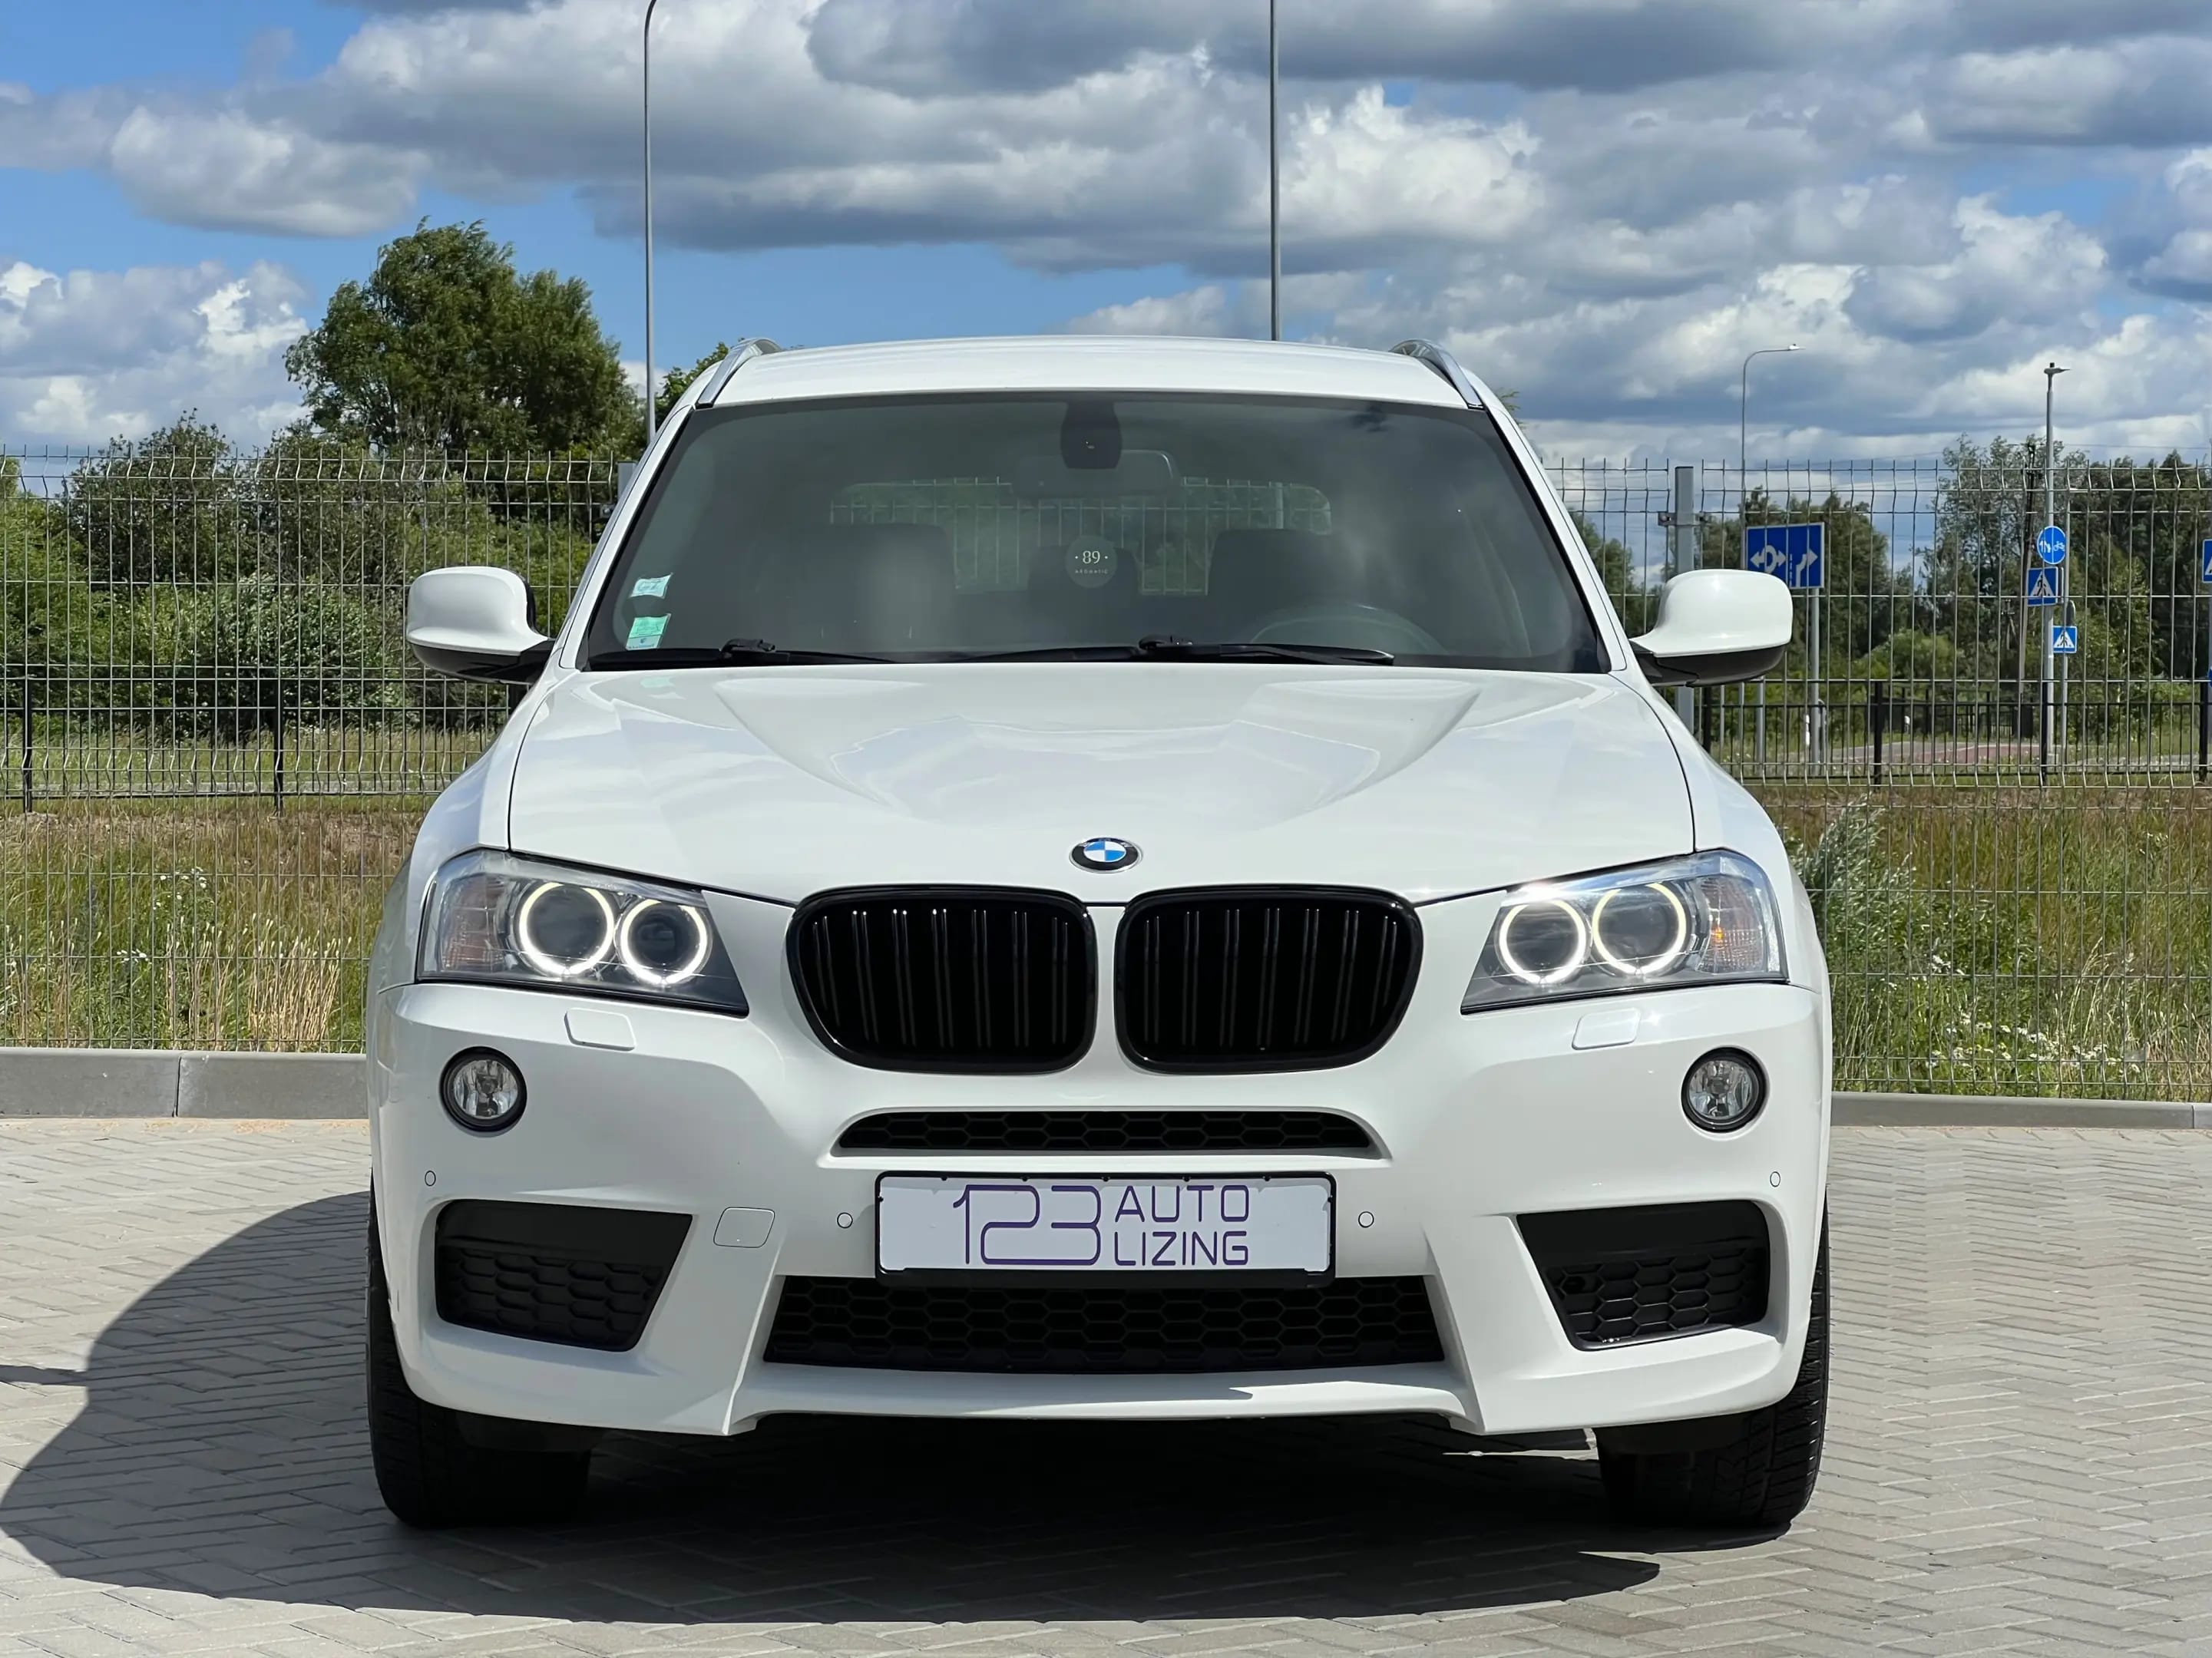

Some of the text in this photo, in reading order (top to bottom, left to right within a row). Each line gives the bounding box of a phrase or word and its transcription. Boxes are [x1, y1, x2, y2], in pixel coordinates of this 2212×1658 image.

[1115, 1184, 1249, 1223] AUTO
[953, 1184, 1101, 1265] 123
[1115, 1231, 1249, 1266] LIZING
